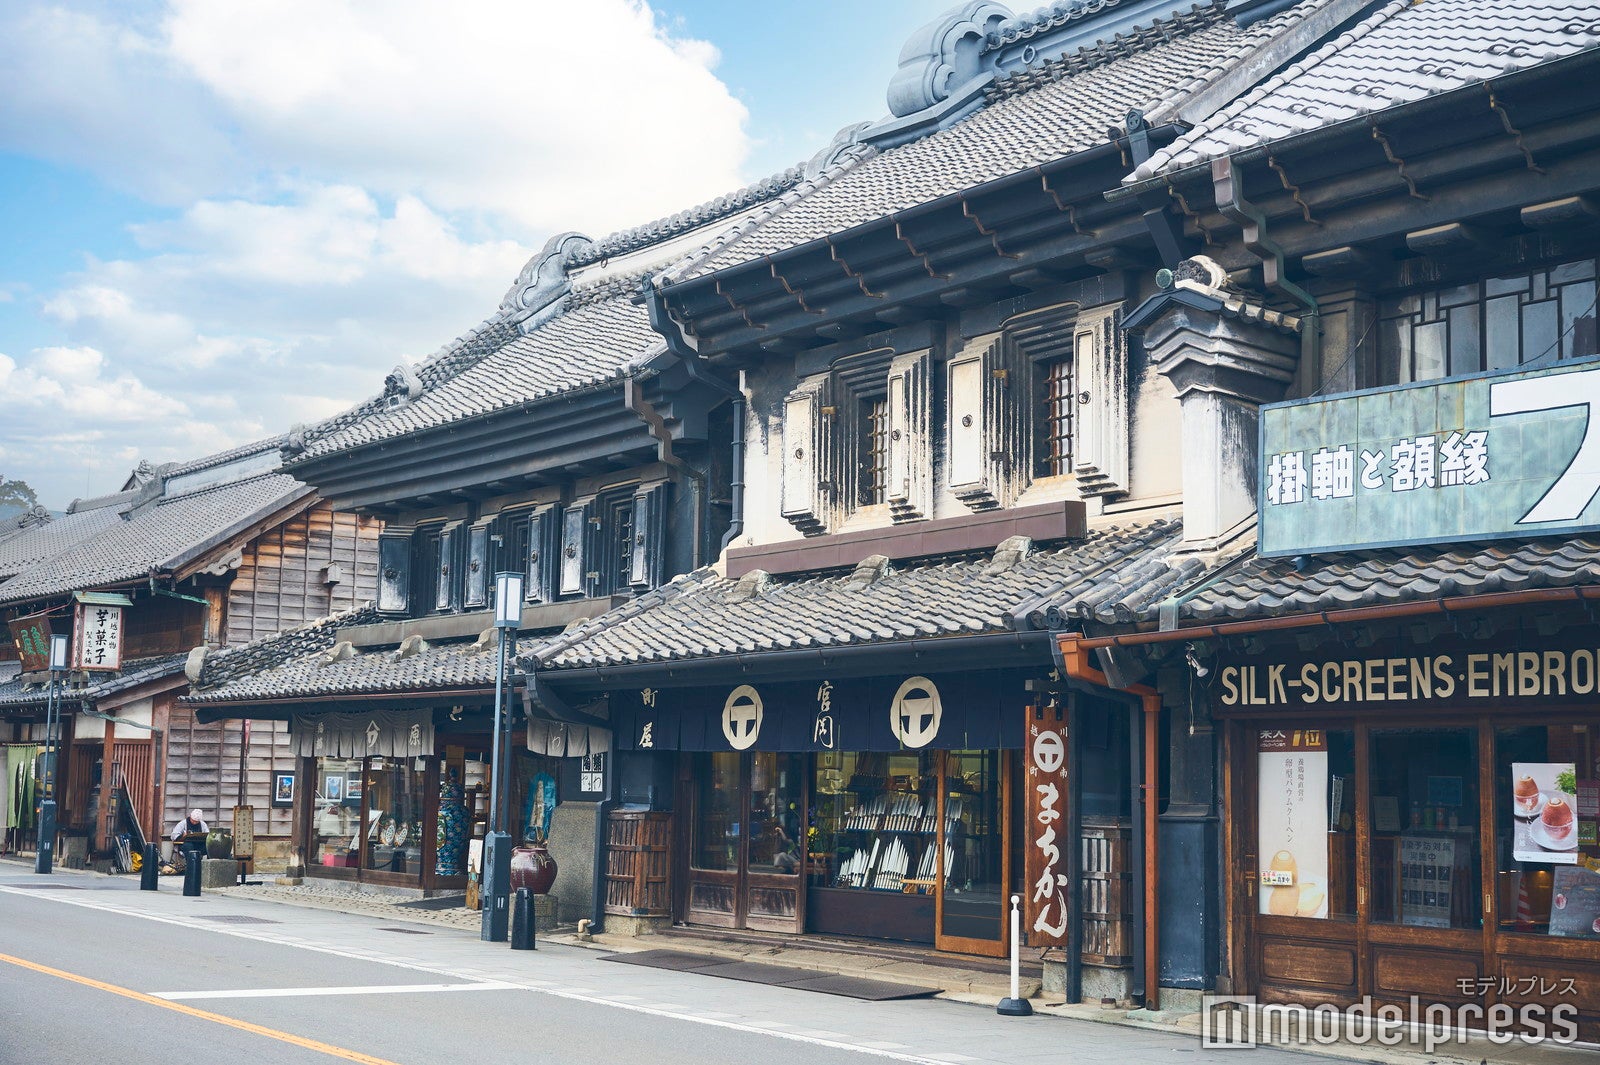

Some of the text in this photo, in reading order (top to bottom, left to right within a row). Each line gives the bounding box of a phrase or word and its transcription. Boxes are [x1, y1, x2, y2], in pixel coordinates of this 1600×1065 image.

[1267, 430, 1491, 505] 掛軸と額縁
[95, 608, 109, 665] 芋菓子
[1032, 781, 1068, 939] まちかん
